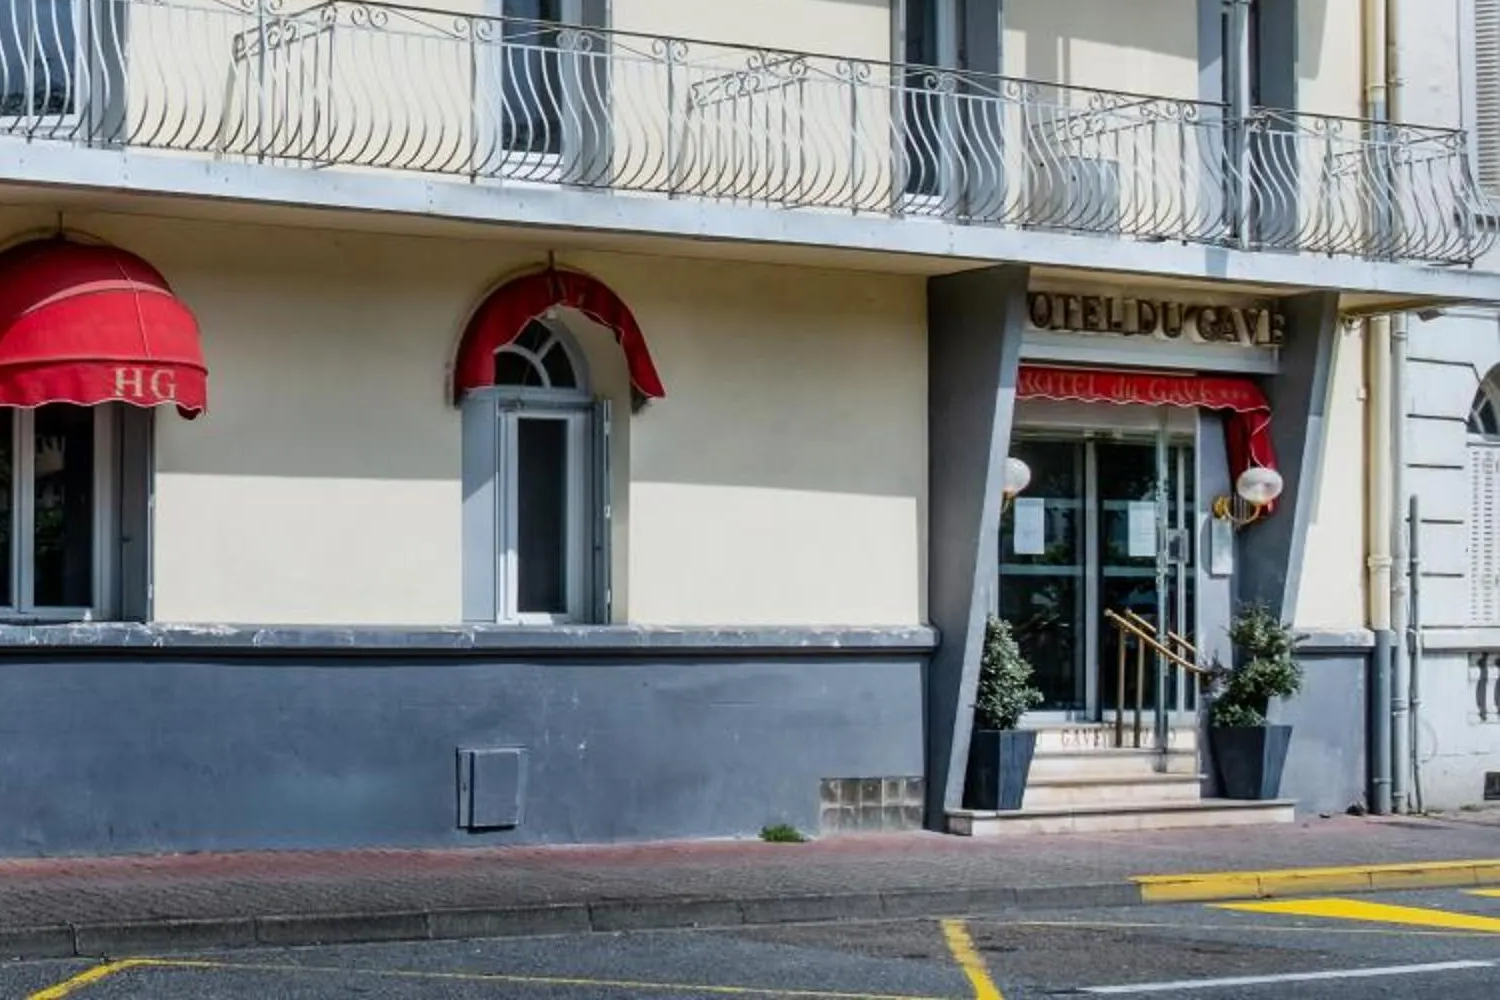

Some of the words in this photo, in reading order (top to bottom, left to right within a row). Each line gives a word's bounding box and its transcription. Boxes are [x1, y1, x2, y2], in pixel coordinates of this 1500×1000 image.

[1029, 291, 1123, 335] OTEL
[1124, 297, 1184, 338] DU
[1184, 302, 1285, 346] GAVE
[113, 366, 177, 400] HG
[1111, 375, 1138, 400] du
[1150, 378, 1213, 404] GAVE
